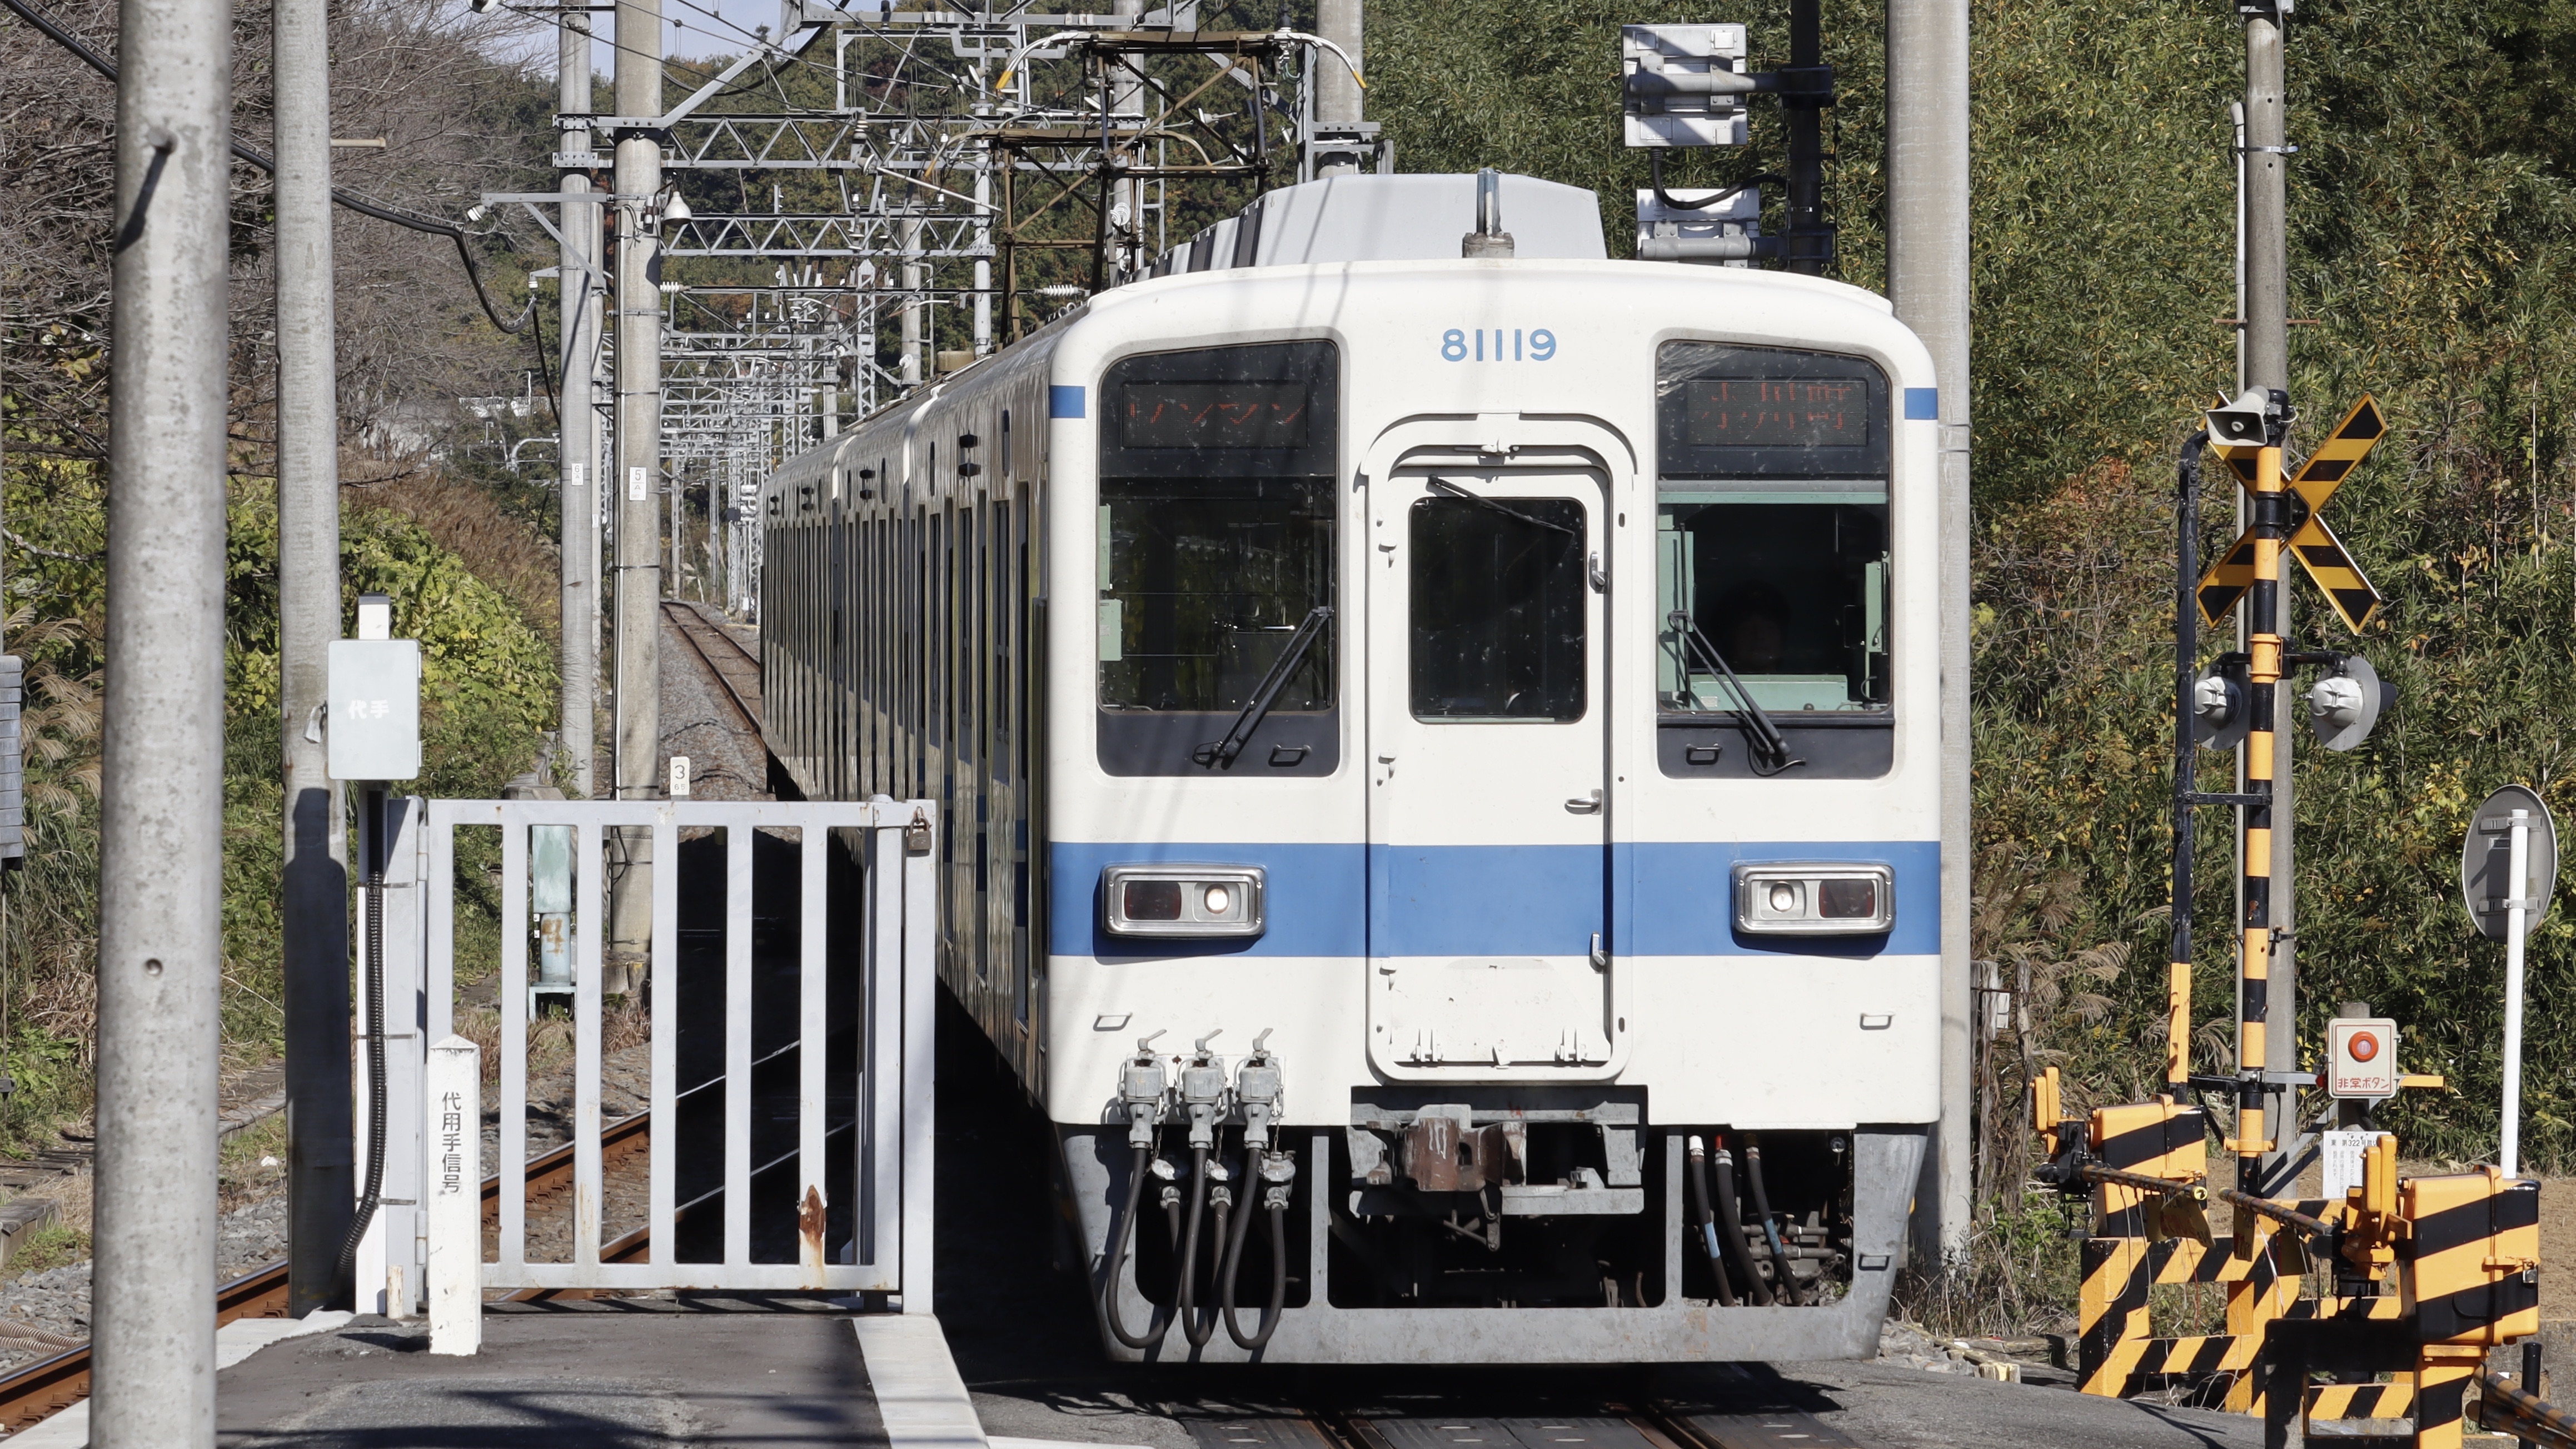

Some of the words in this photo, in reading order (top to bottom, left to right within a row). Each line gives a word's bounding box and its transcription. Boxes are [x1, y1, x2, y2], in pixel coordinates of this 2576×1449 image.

[1441, 328, 1557, 362] 81119
[635, 469, 641, 481] 5
[348, 700, 390, 719] 代手
[675, 765, 685, 779] 3
[2338, 1077, 2389, 1089] 非常ボタン
[442, 1092, 461, 1193] 代用手信号
